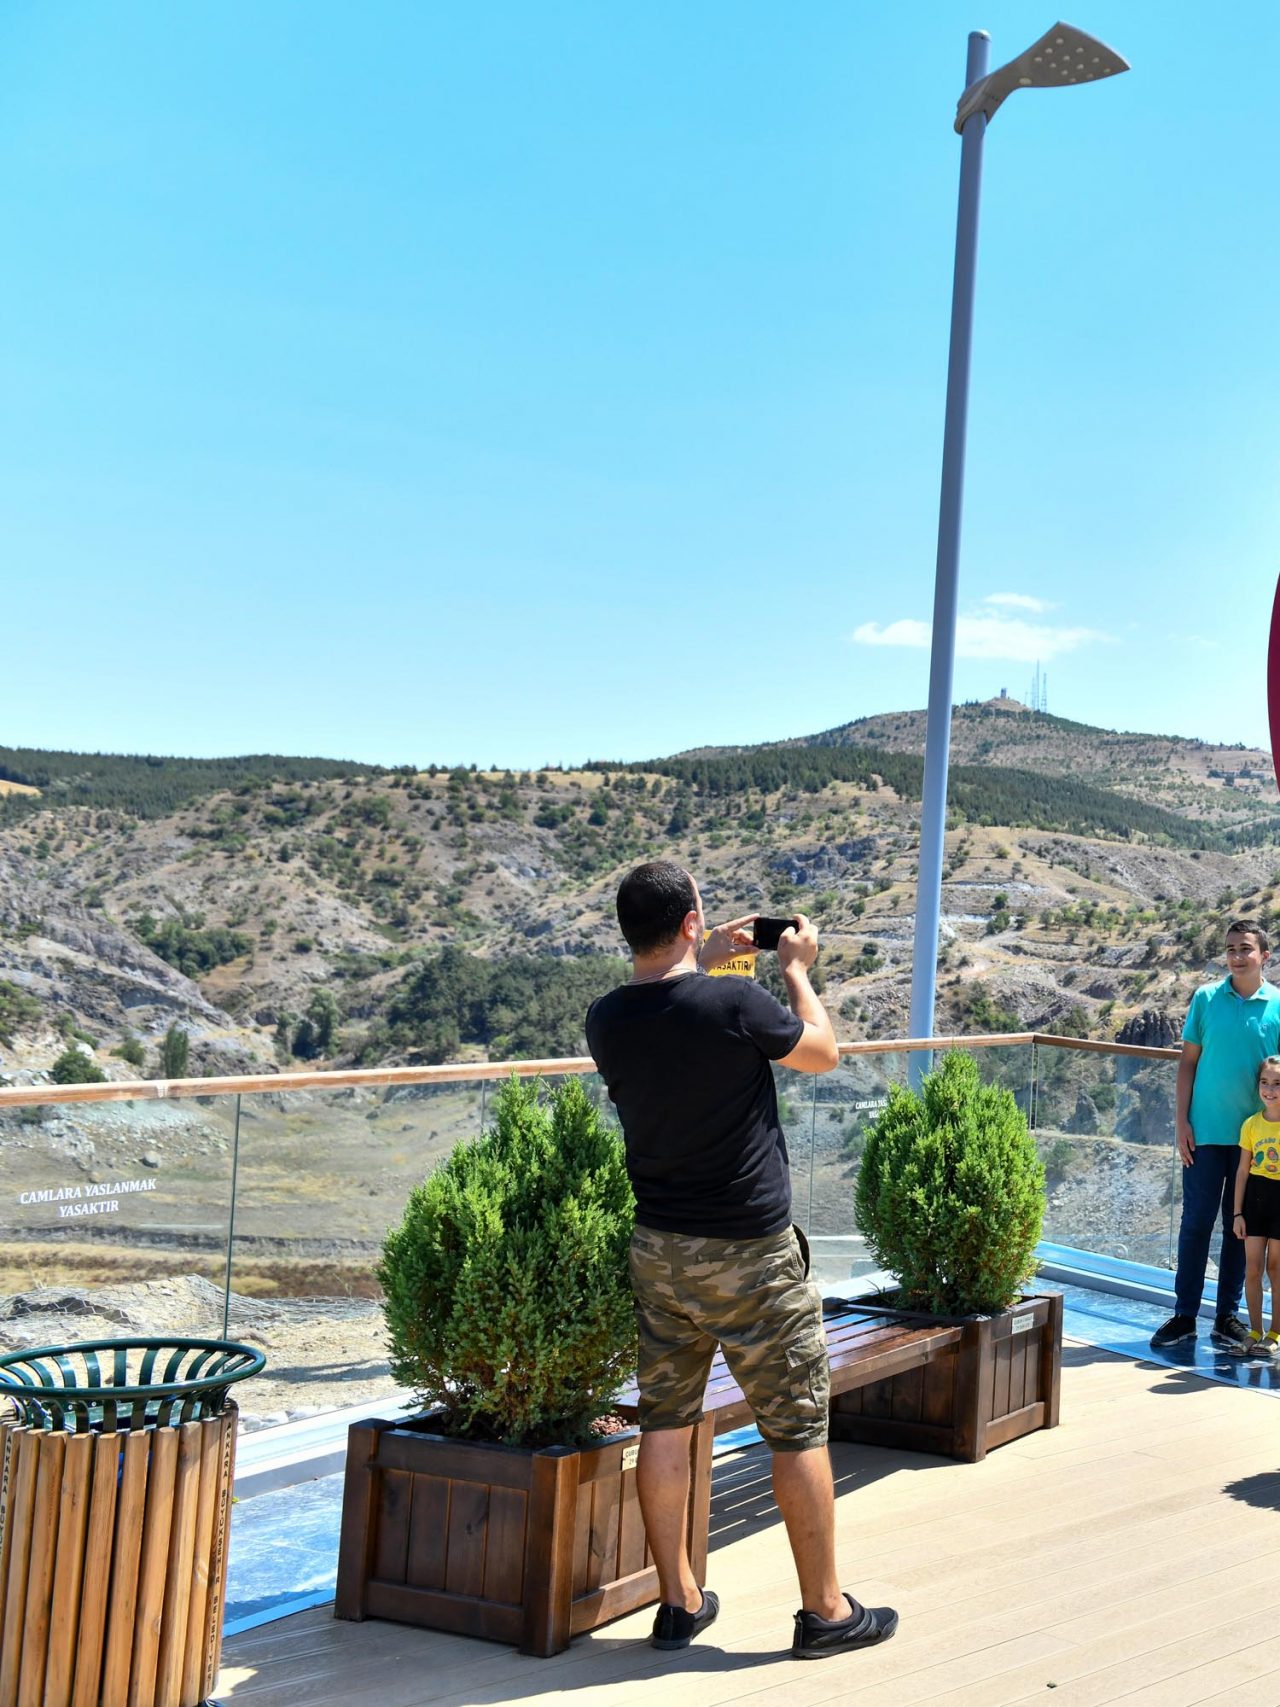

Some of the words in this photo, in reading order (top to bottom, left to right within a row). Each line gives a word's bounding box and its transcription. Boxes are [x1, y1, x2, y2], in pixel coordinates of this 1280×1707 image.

[713, 960, 749, 971] ASAKTIR
[20, 1187, 82, 1204] CAMLARA
[84, 1178, 157, 1197] YASLANMAK
[59, 1200, 119, 1217] YASAKTIR
[223, 1422, 231, 1478] ANKARA
[2, 1435, 11, 1495] ANKARA
